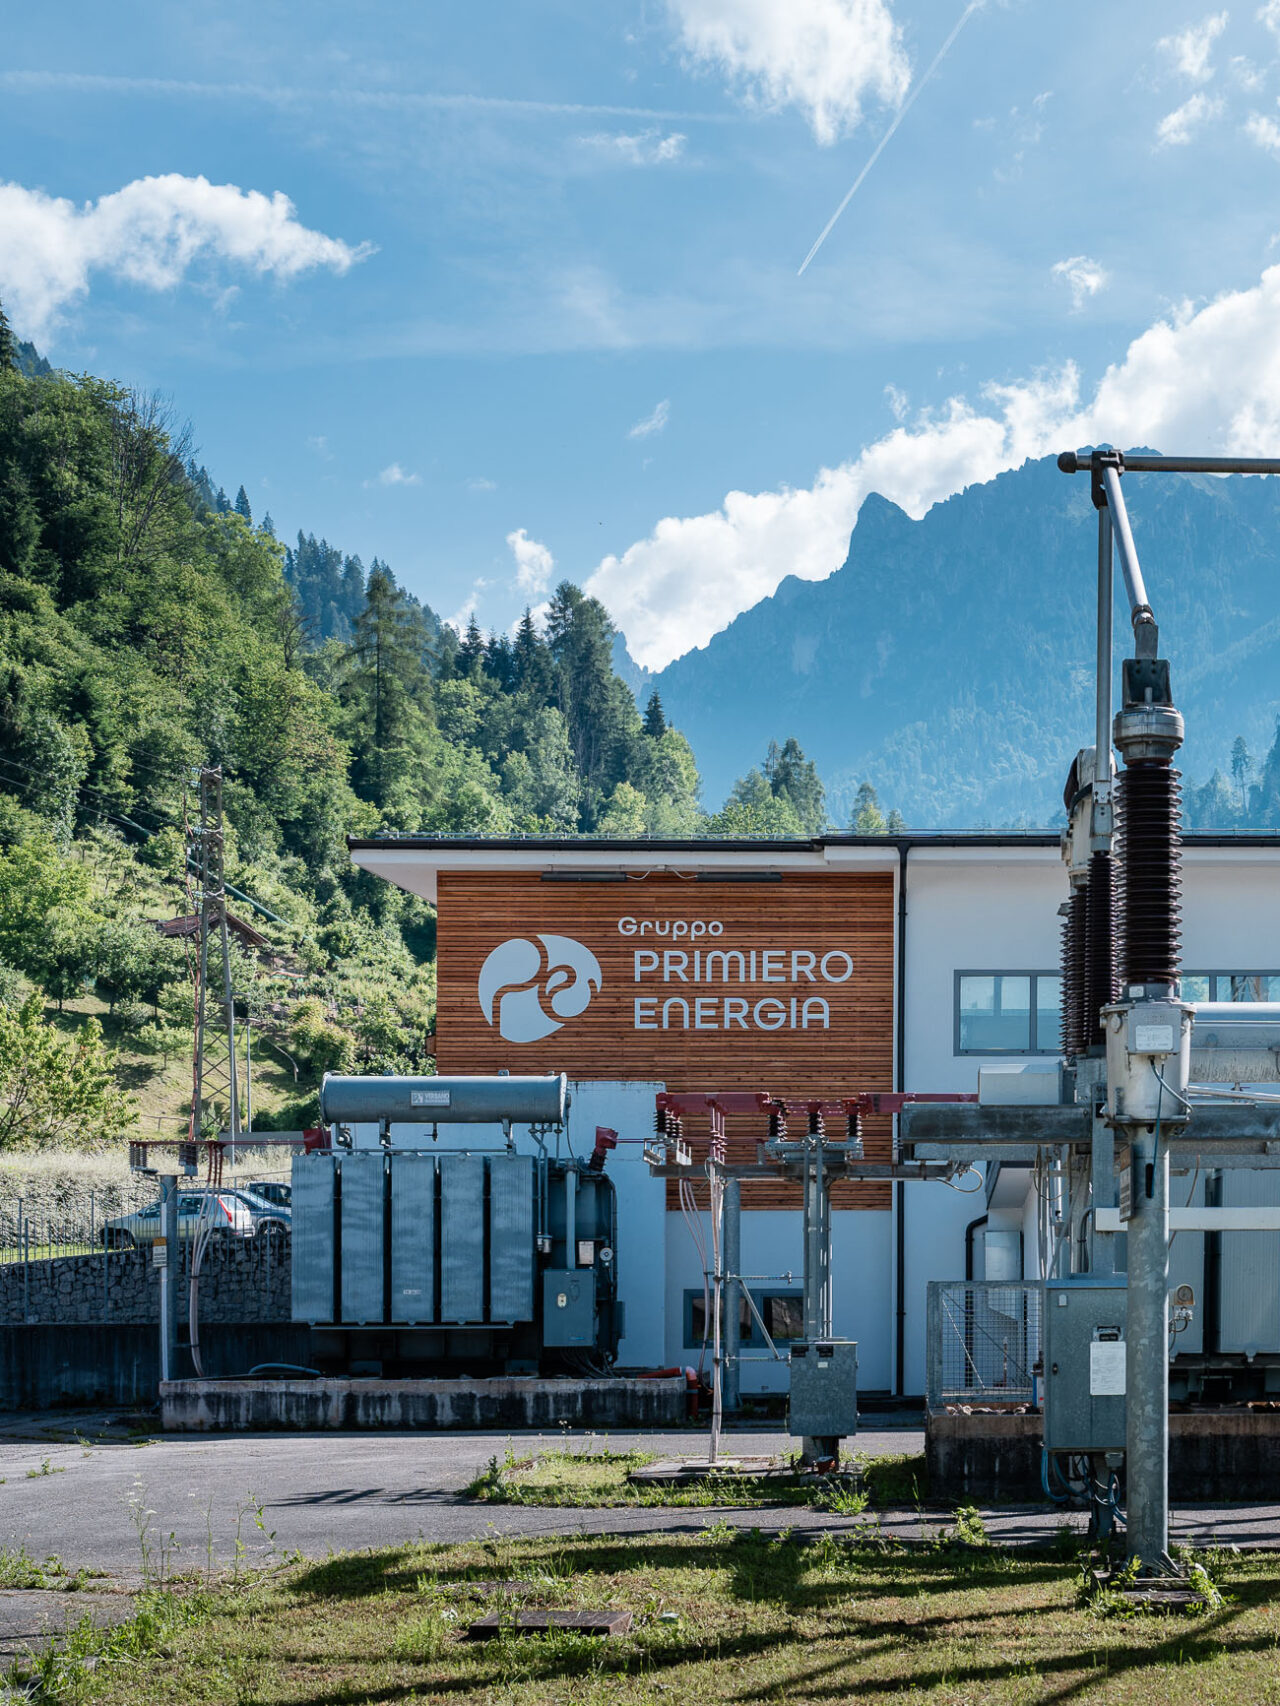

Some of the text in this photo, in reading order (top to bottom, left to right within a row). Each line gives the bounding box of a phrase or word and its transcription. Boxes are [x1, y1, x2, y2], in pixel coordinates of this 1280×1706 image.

[617, 916, 724, 941] Gruppo
[634, 950, 854, 983] PRIMIERO
[634, 997, 830, 1031] ENERGIA
